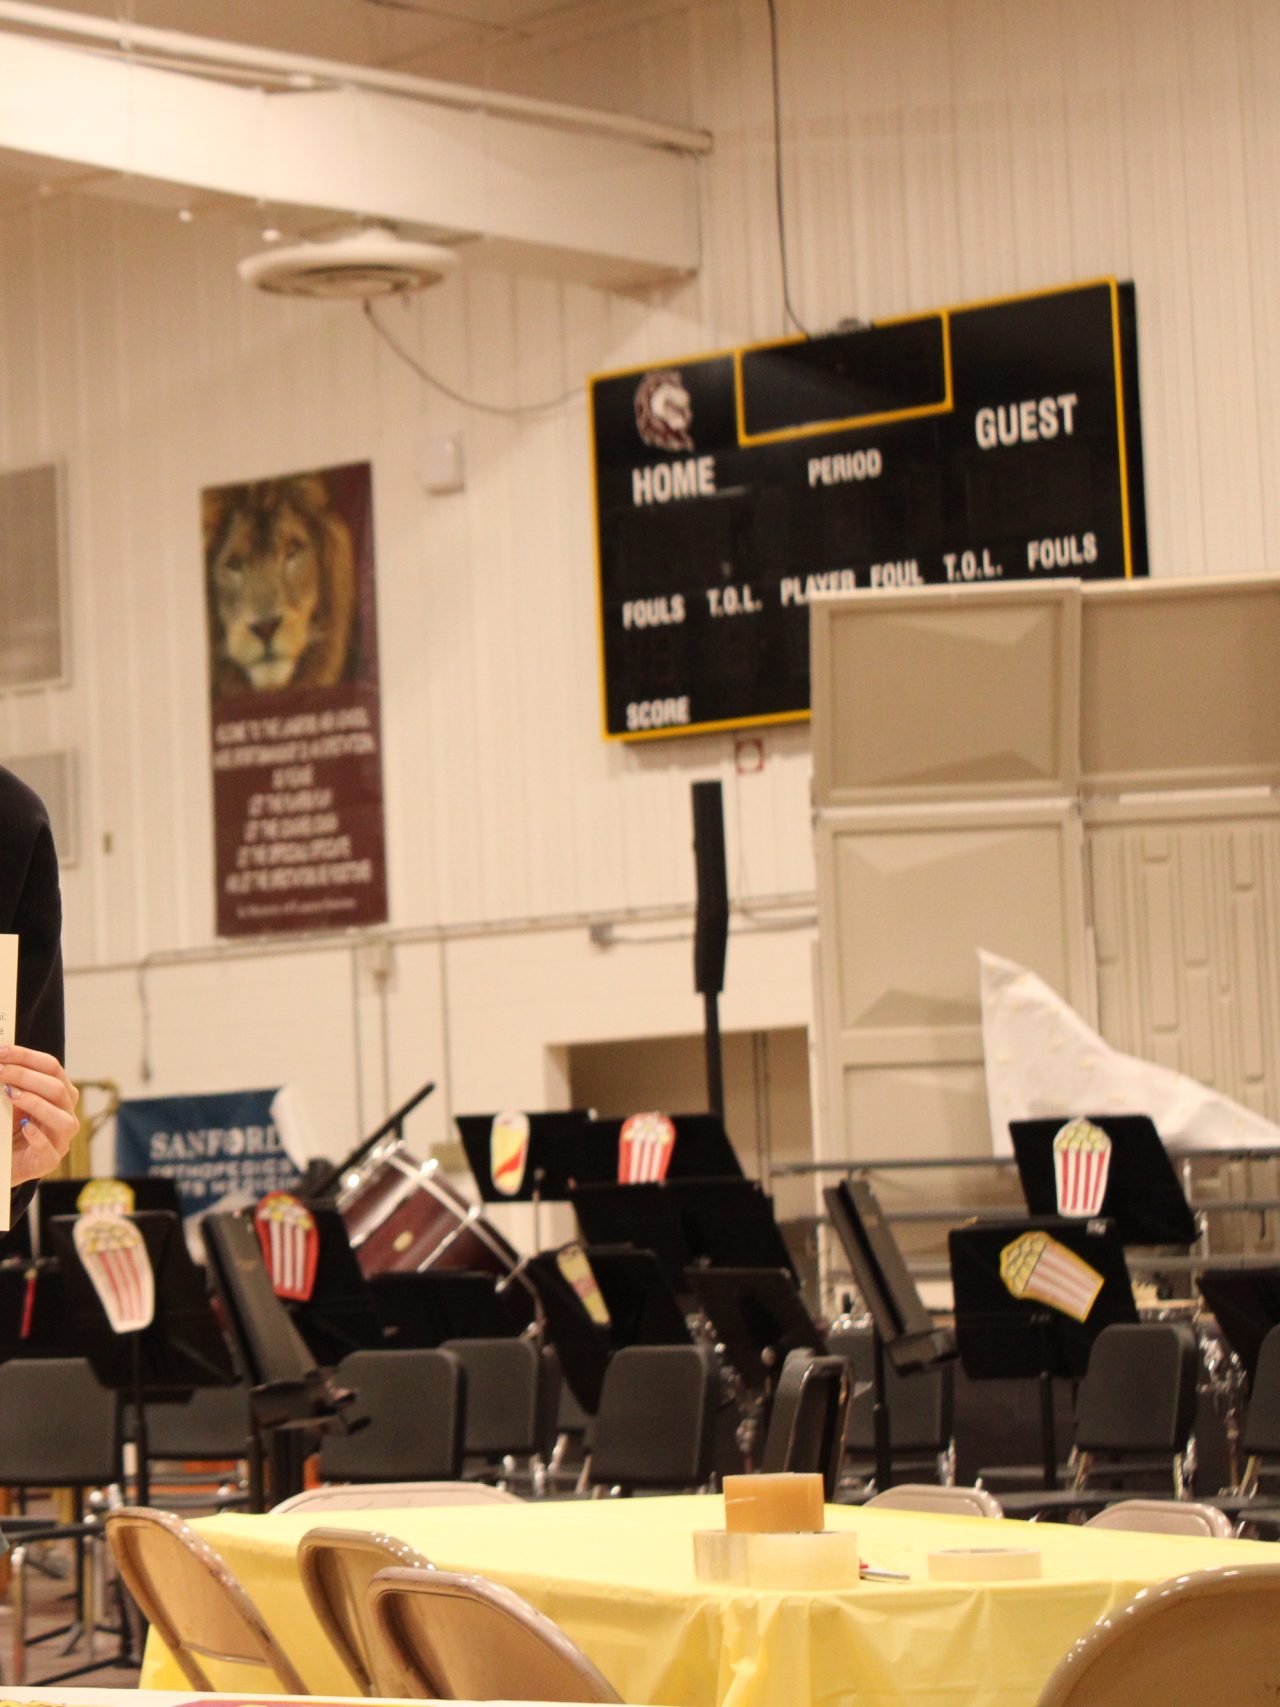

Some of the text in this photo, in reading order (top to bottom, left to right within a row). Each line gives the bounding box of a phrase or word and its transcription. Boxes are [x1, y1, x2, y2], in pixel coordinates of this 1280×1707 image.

[975, 394, 1077, 449] GUEST
[633, 456, 715, 506] HOME
[808, 448, 882, 487] PERIOD
[943, 547, 1003, 582] T.O.L.
[1027, 532, 1098, 571] FOULS
[707, 584, 761, 617] T.O.L.
[780, 559, 925, 606] PLAYER FOUL
[623, 594, 685, 629] FOULS
[627, 696, 690, 730] SCORE
